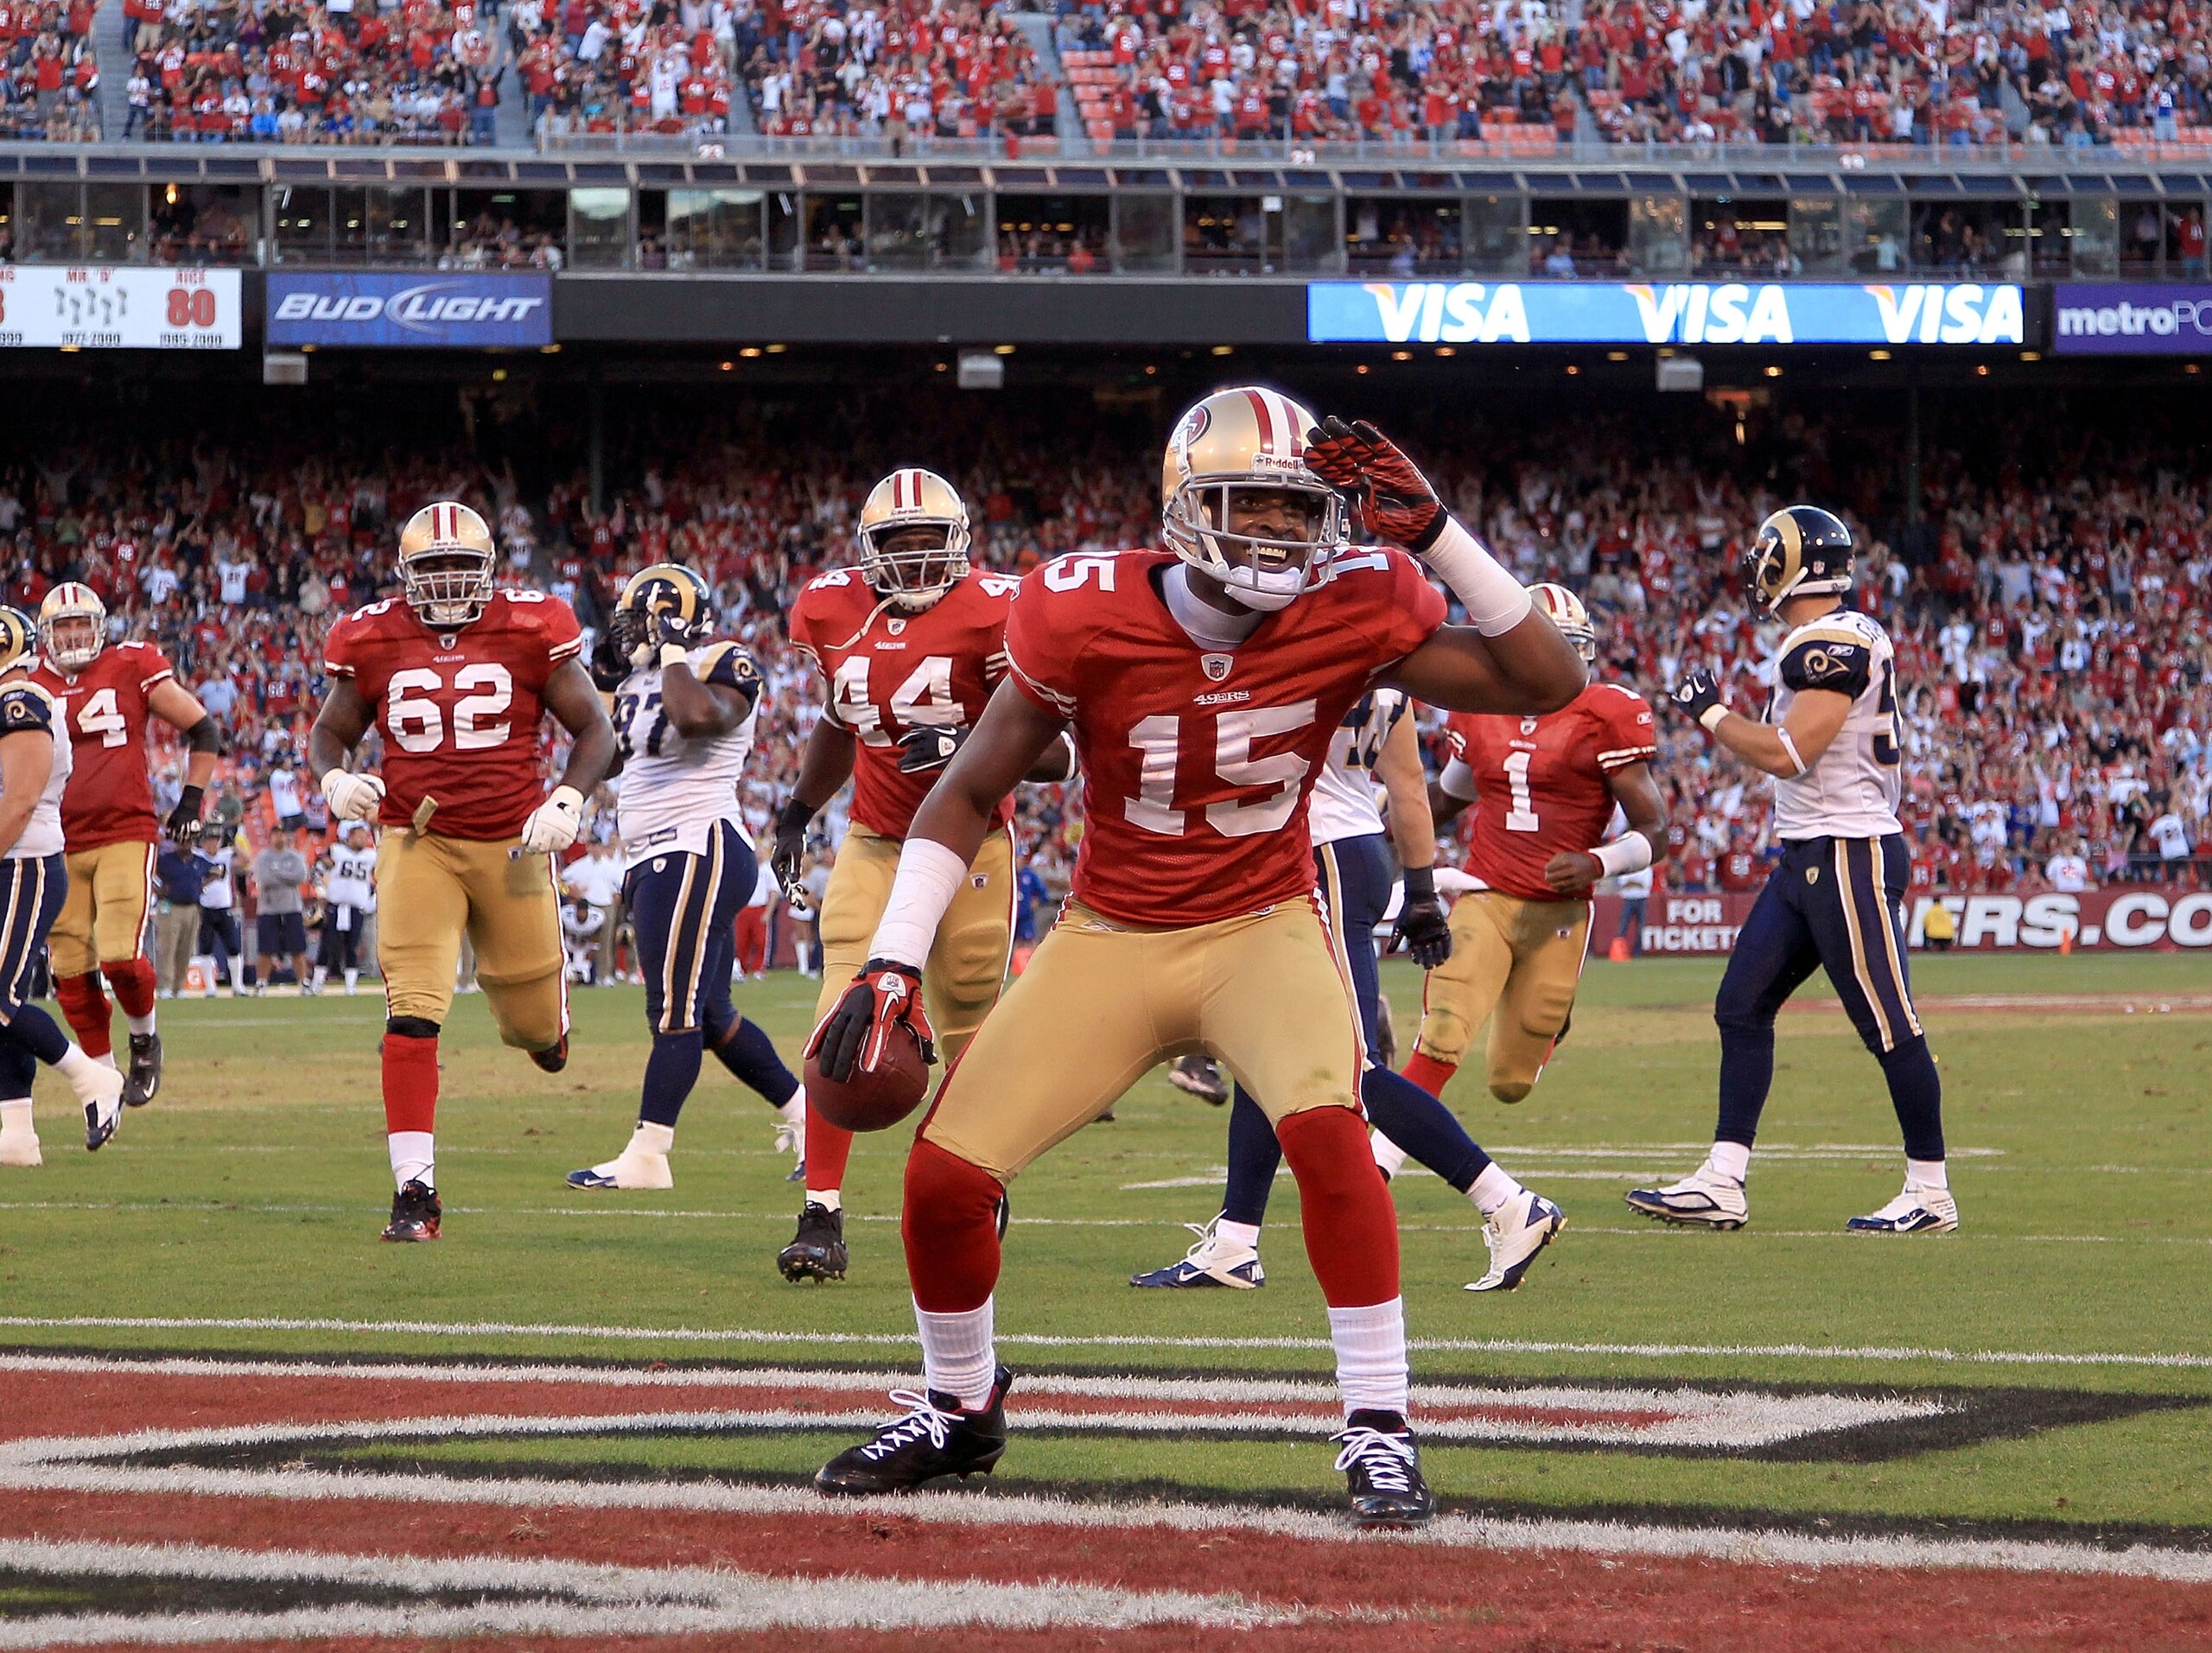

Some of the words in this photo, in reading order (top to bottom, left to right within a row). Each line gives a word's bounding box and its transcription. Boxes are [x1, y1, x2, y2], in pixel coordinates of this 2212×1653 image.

[168, 289, 216, 327] 80
[275, 293, 386, 321] BUD
[402, 295, 543, 321] LIGHT
[1363, 283, 1531, 342] VISA
[1624, 283, 1795, 343] VISA
[1864, 284, 2024, 343] VISA
[1265, 457, 1299, 469] Riddell
[388, 663, 512, 753] 62
[834, 656, 969, 747] 44
[1193, 690, 1250, 705] 49ERS
[1123, 698, 1317, 837] 15
[1503, 751, 1541, 832] 1
[1666, 899, 1723, 924] FOR
